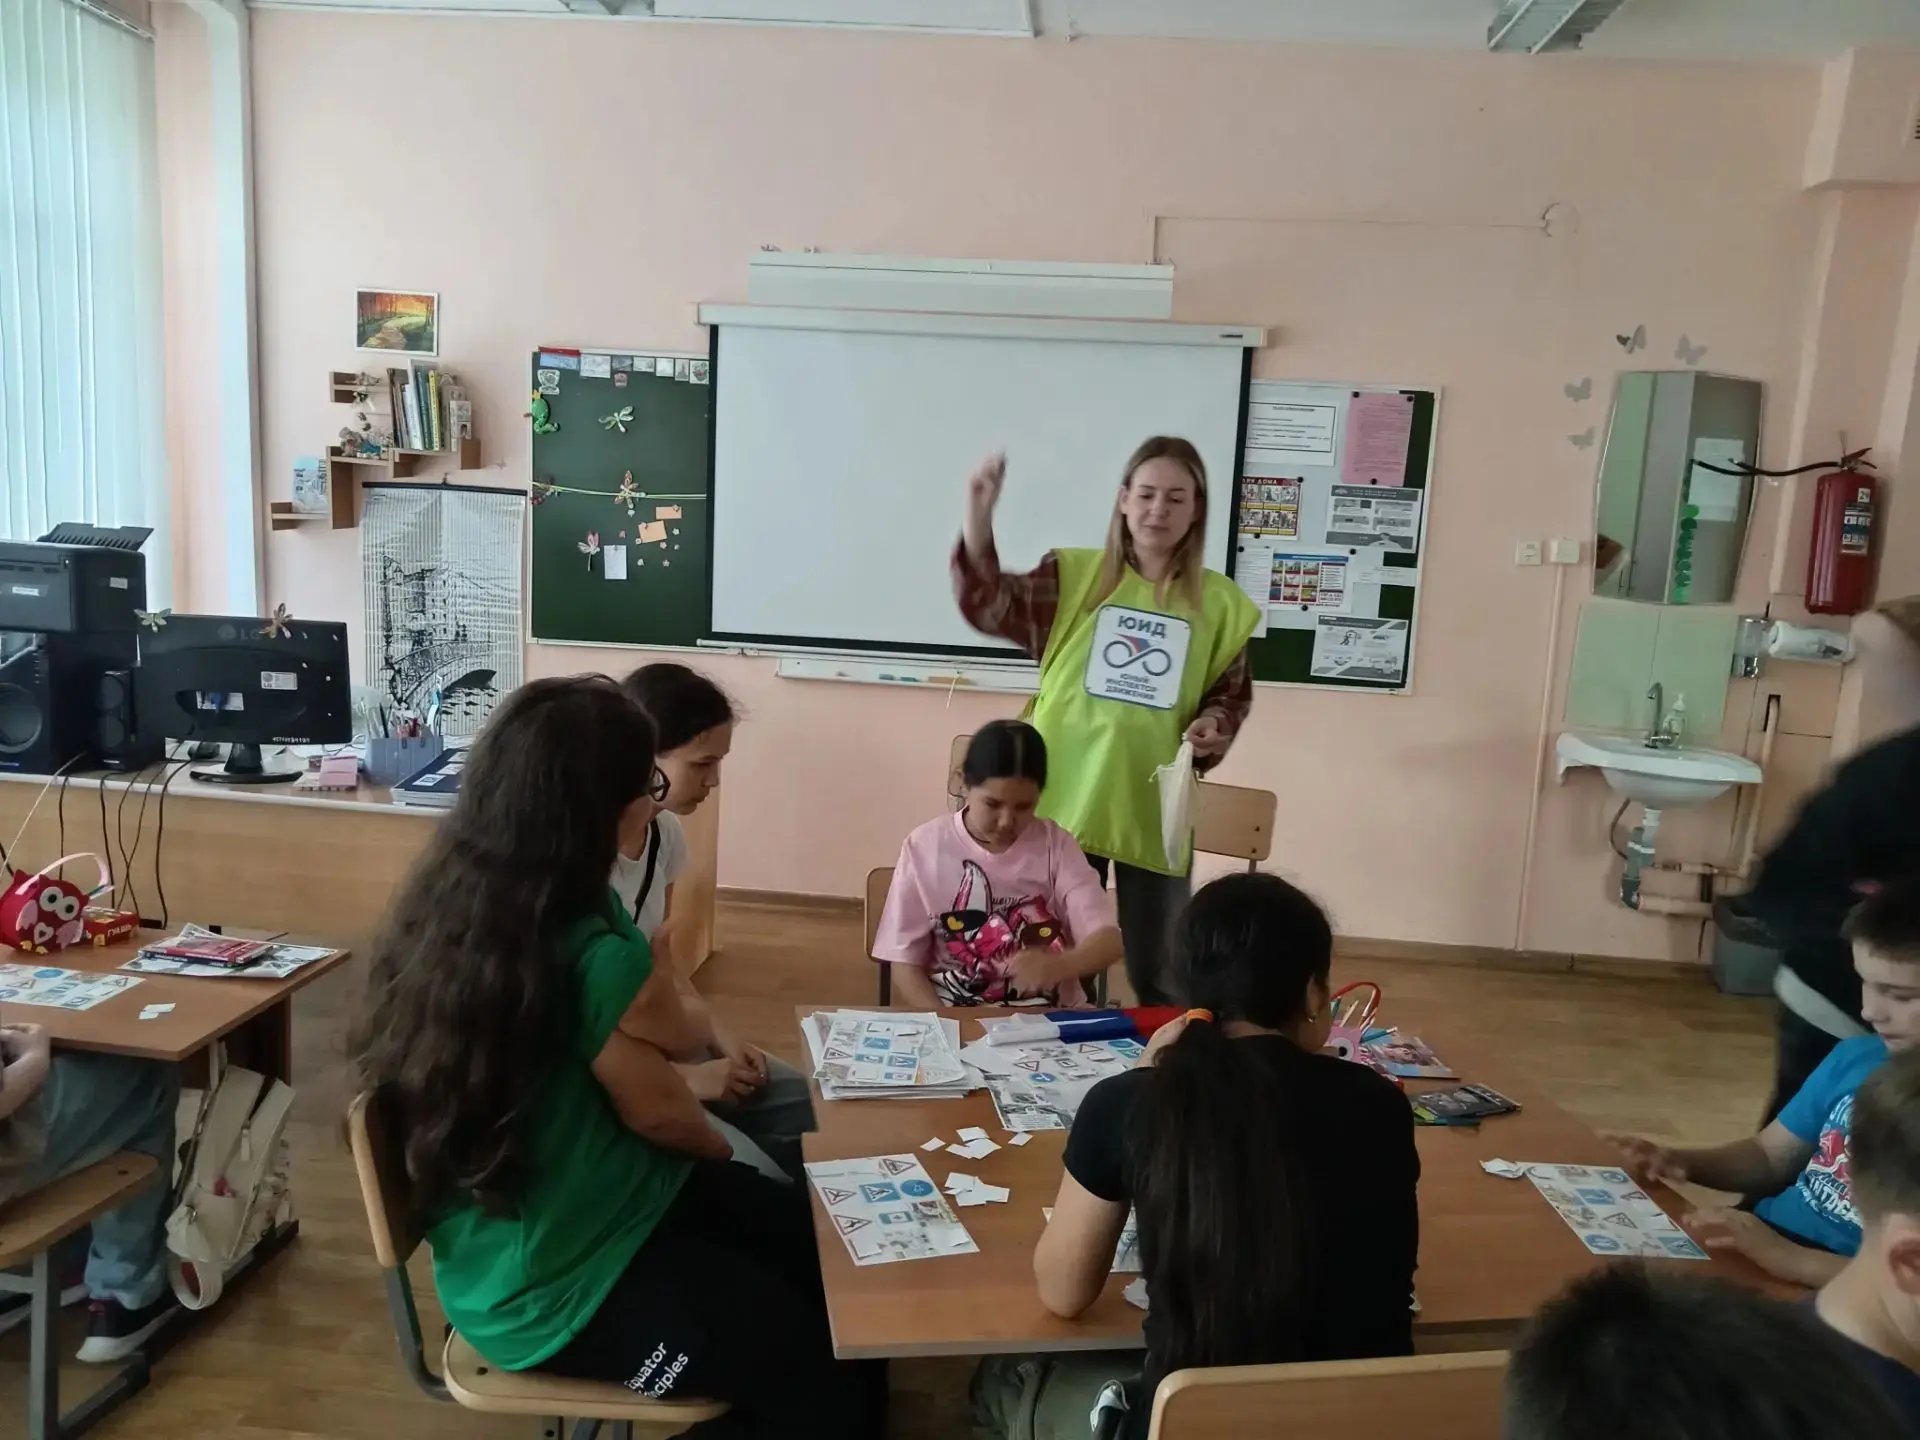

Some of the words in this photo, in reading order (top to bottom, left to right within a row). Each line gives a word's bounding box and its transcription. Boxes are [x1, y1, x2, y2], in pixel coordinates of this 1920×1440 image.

[1117, 615, 1167, 639] ЮИД
[240, 629, 261, 640] LG
[1105, 678, 1157, 691] ИНСПЕКТОР
[1120, 673, 1149, 683] ЮНЫЙ
[1105, 686, 1155, 699] ДВИЖЕНИЯ
